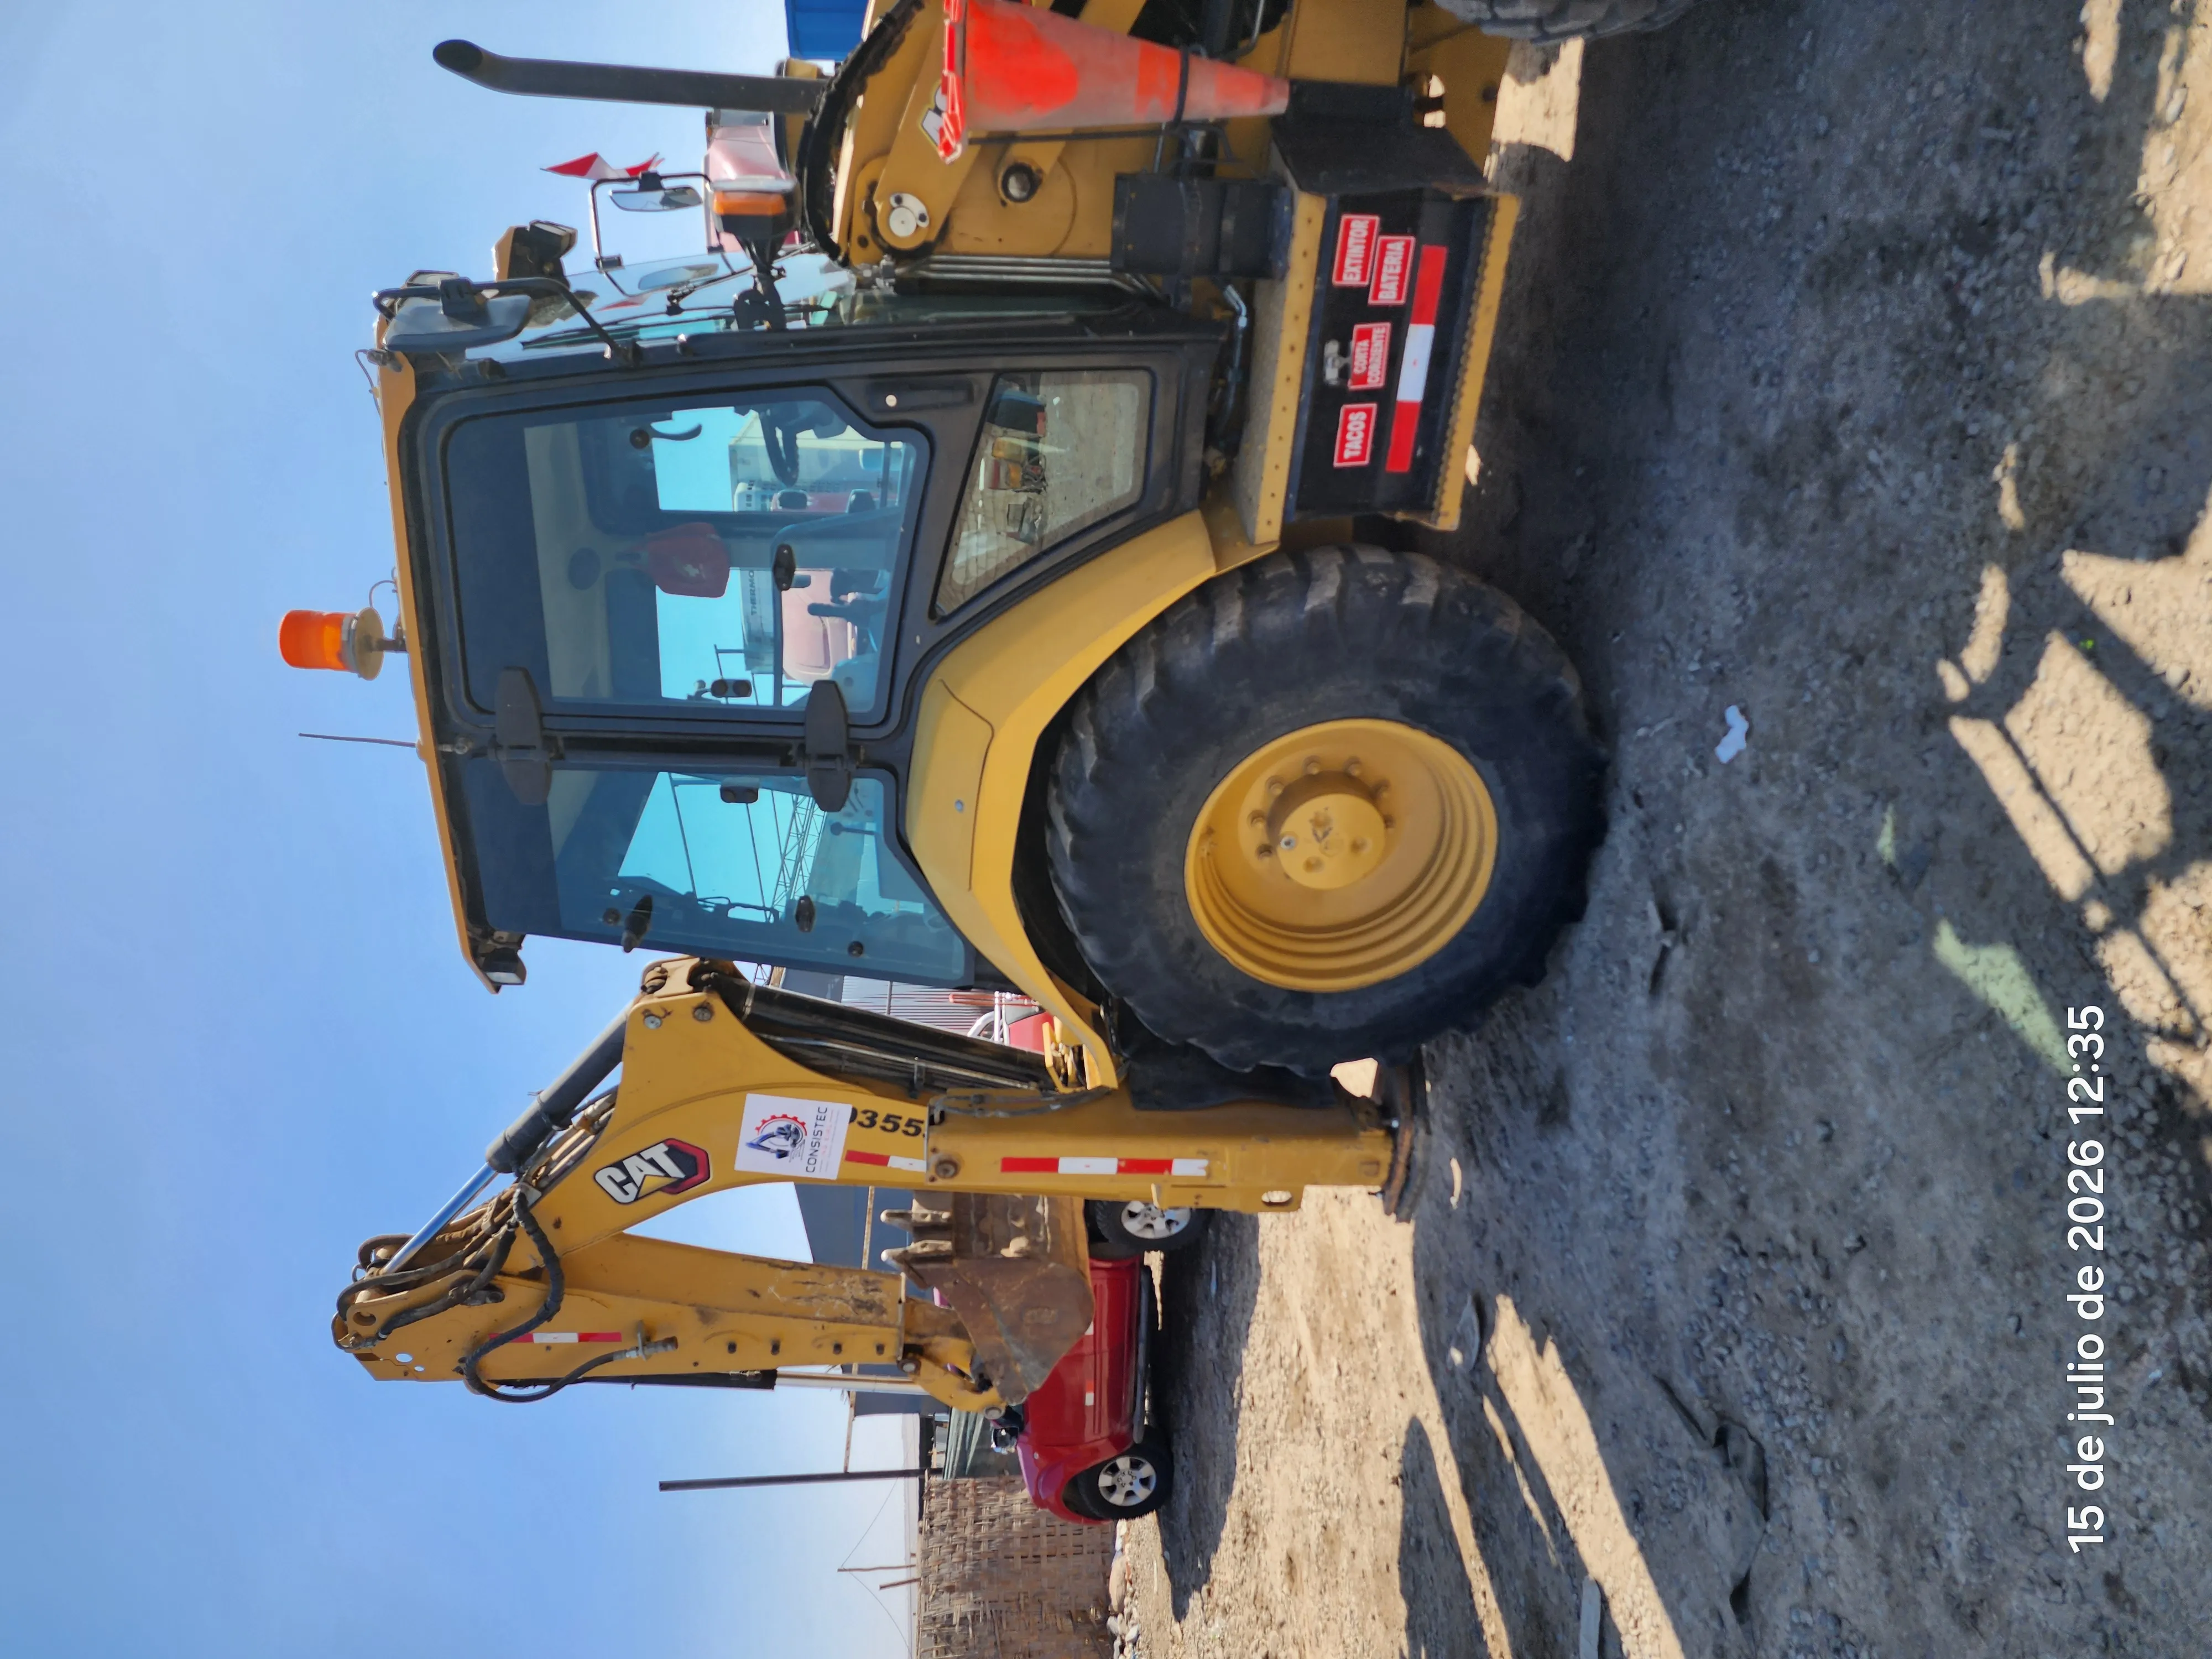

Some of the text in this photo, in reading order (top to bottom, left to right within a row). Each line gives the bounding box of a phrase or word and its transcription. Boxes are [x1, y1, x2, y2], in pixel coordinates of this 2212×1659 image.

[1342, 219, 1369, 281] EXTINTOR
[1378, 241, 1405, 300] BATERIA
[1353, 338, 1370, 374] CORTA
[1366, 327, 1386, 384] CORRIENTE
[1343, 411, 1368, 460] TACOS
[748, 570, 757, 615] THERMO
[805, 1106, 828, 1173] CONSISTEC
[594, 1142, 686, 1203] CAT
